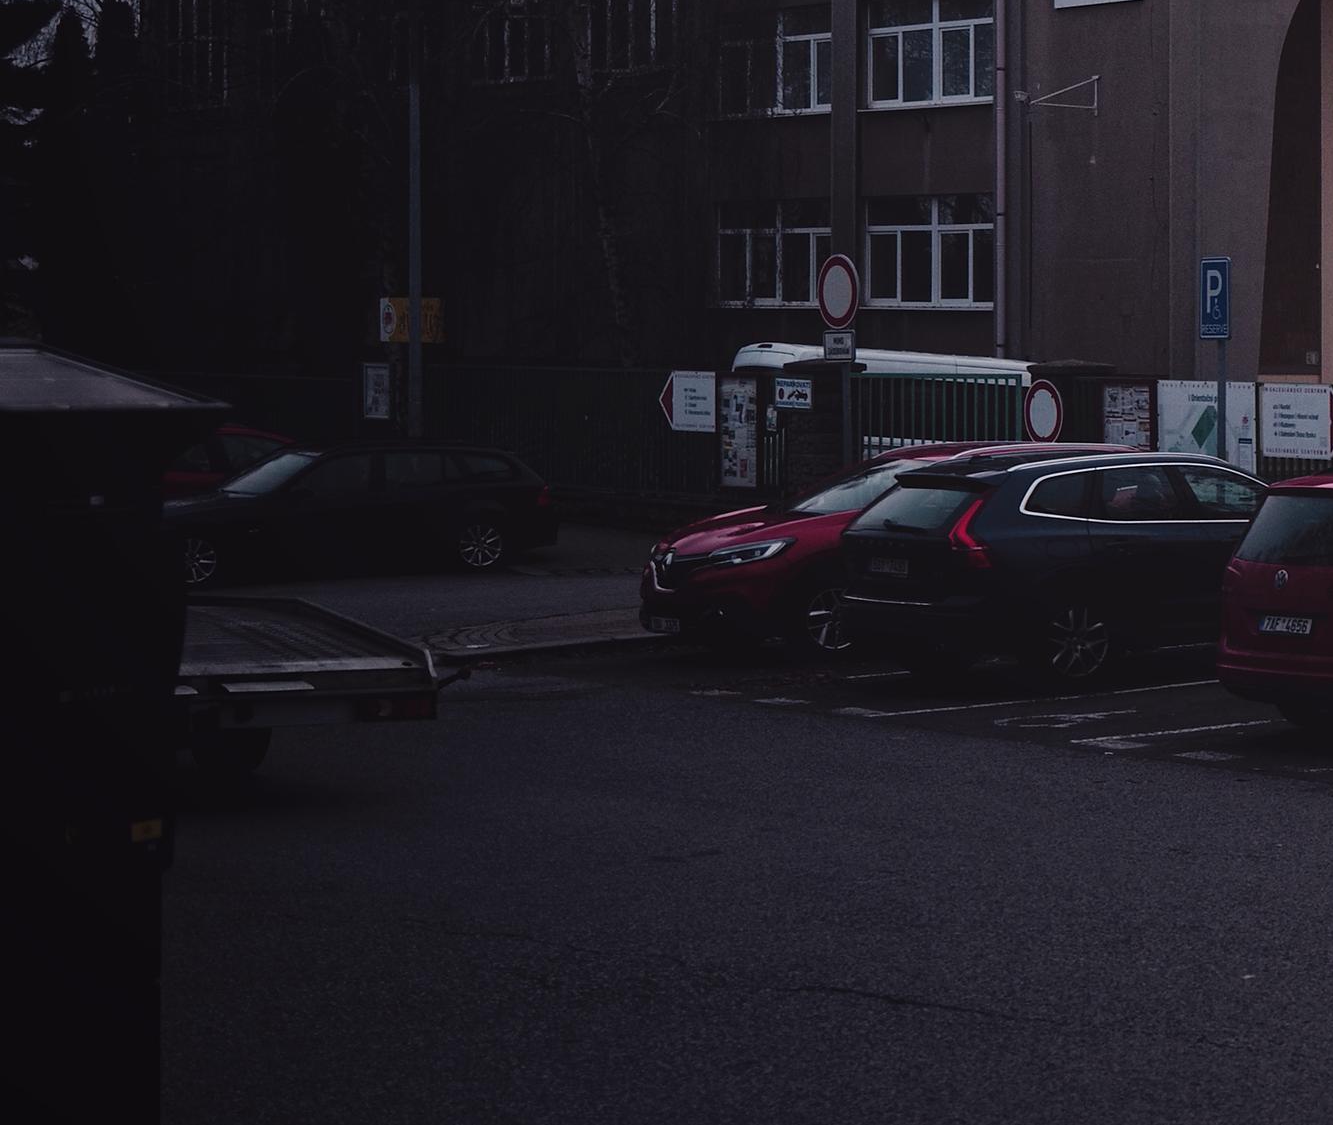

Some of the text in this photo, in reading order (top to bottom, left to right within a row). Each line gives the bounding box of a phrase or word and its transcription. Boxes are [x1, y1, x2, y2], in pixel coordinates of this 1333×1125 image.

[1206, 269, 1223, 313] P
[1264, 616, 1309, 633] 7AF 4656
